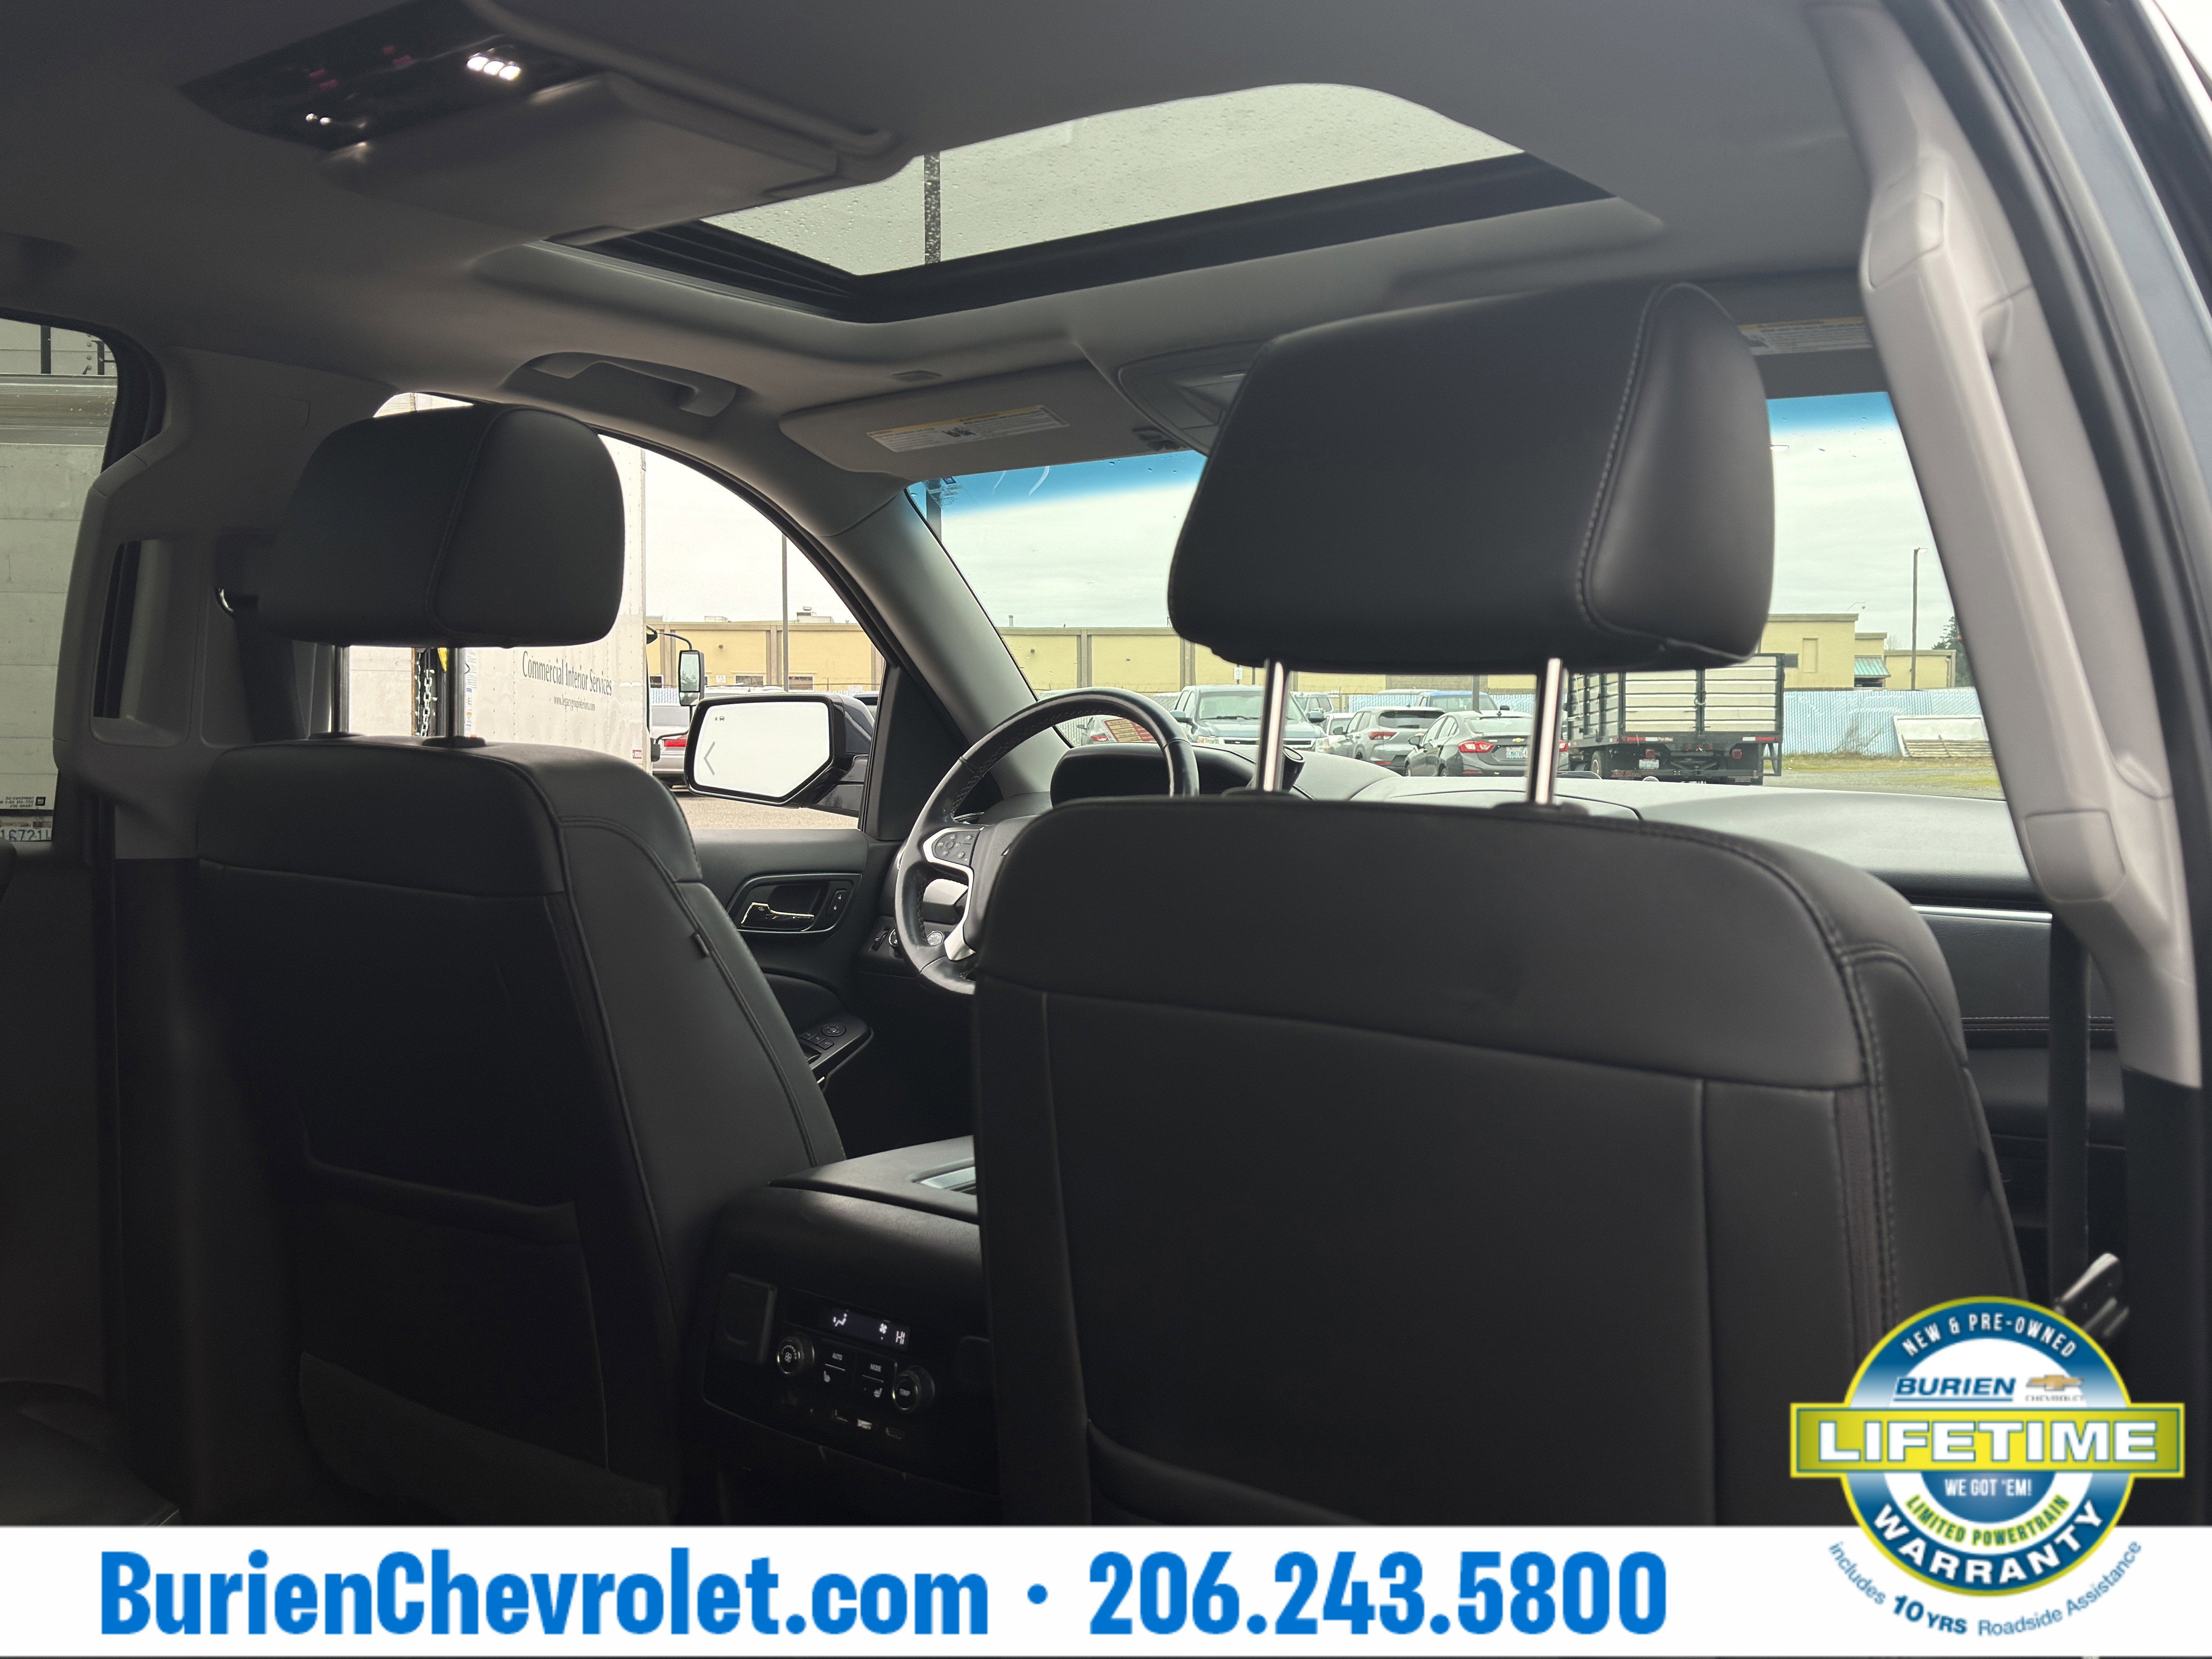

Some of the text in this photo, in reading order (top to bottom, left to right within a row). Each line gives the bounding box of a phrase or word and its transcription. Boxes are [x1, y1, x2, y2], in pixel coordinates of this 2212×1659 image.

[523, 651, 612, 695] Commercial Interior Services
[896, 1331, 905, 1344] HI
[870, 1364, 882, 1372] MODE
[900, 1388, 911, 1397] TEMP
